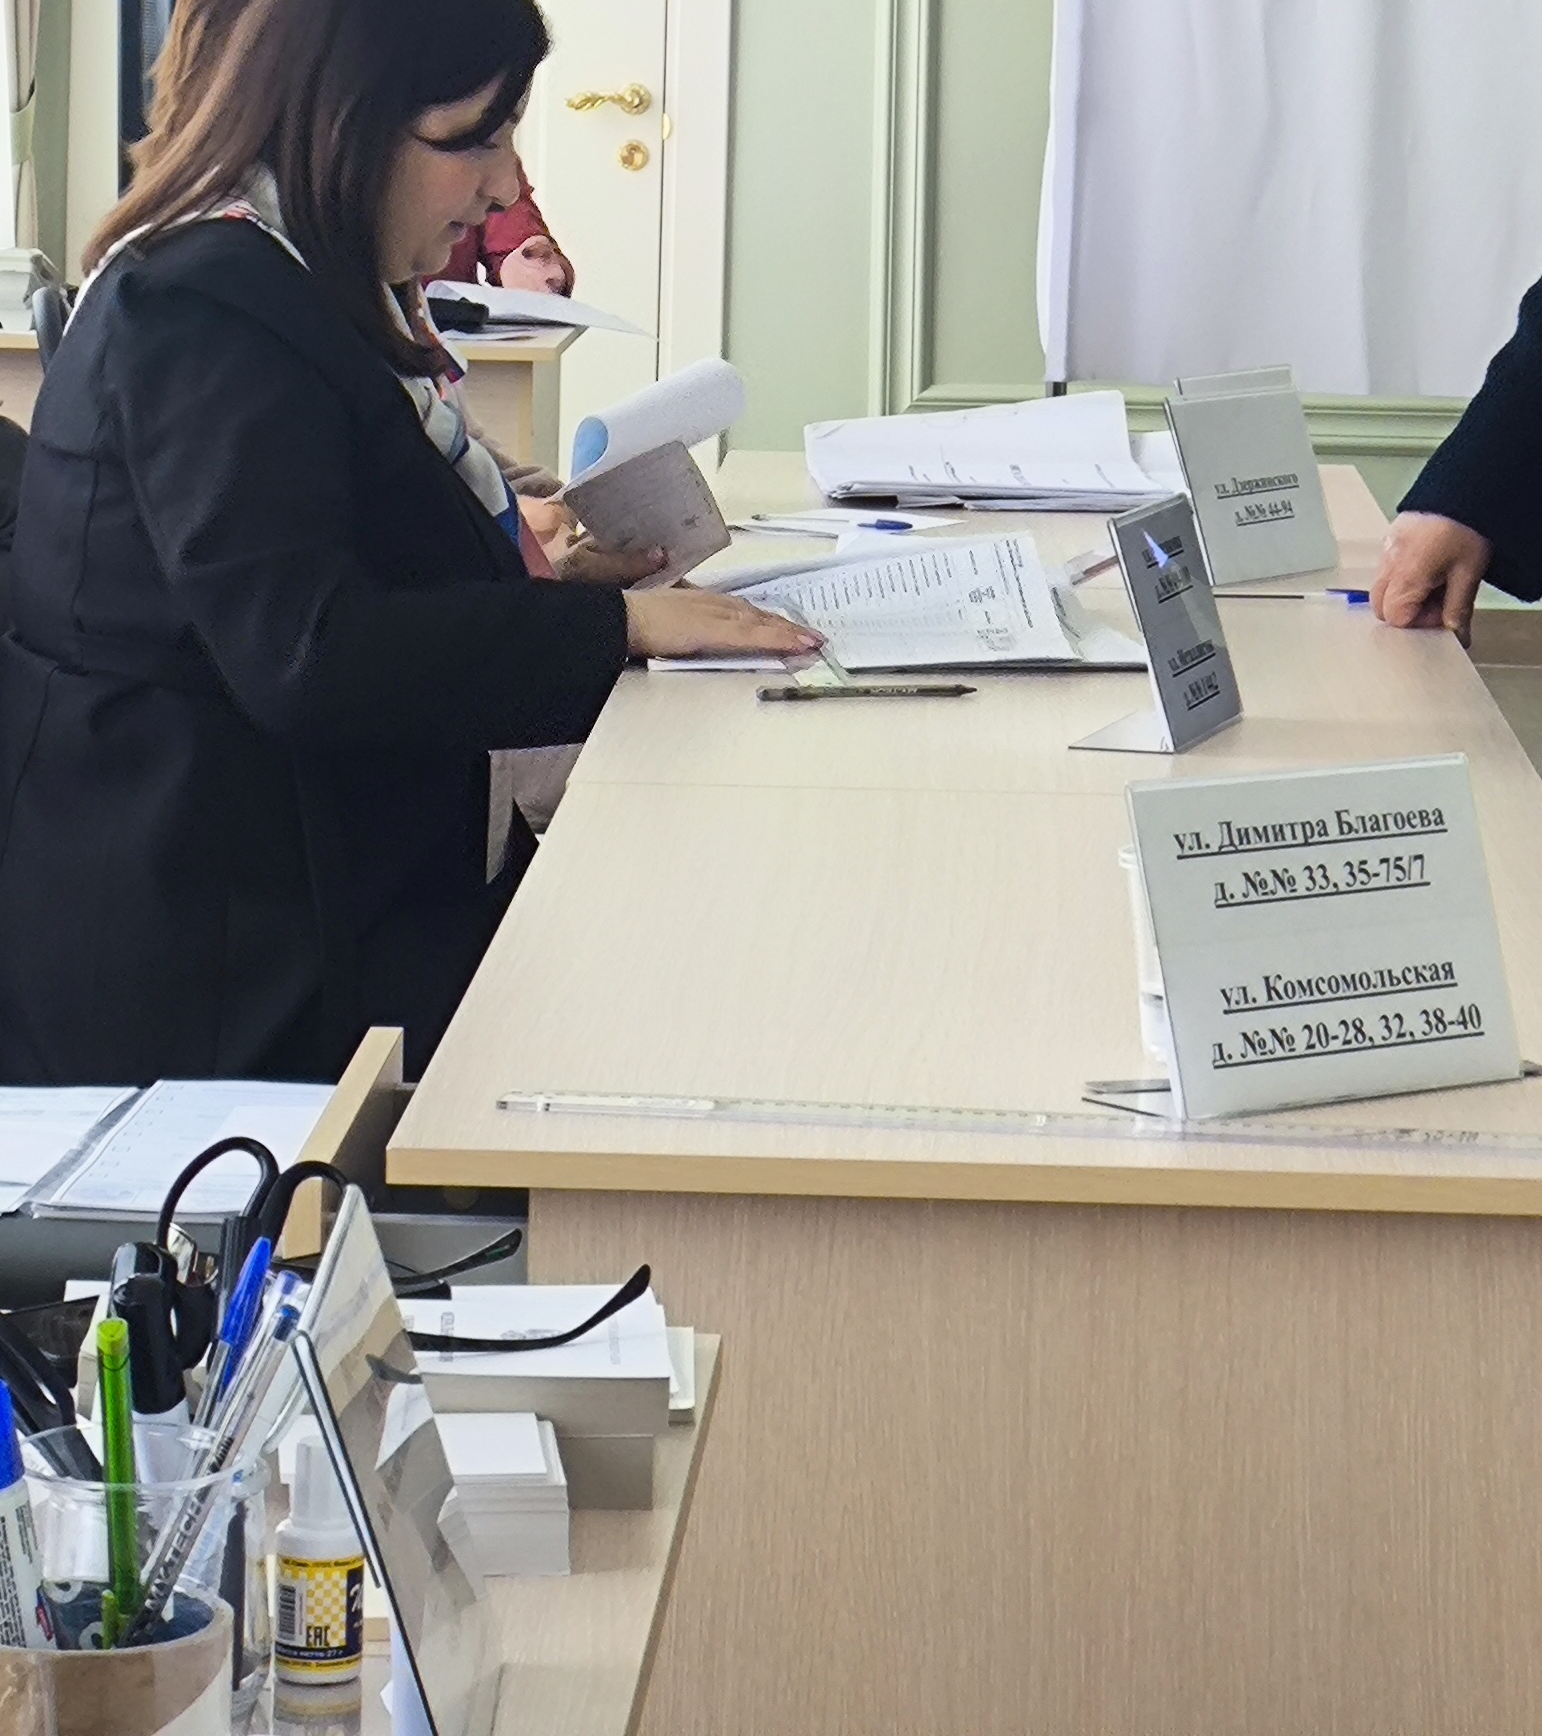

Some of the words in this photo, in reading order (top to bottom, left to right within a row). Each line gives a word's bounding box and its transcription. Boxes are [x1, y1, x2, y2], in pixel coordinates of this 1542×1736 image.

[1173, 828, 1211, 856] ул.
[1217, 818, 1330, 852] Димитра
[1334, 805, 1446, 838] Благоева
[1213, 881, 1236, 906] д.
[1242, 867, 1299, 900] №№
[1303, 862, 1340, 894] 33,
[1344, 853, 1428, 890] 35-75/7
[1220, 982, 1258, 1009] ул.
[1263, 960, 1456, 1004] Комсомольская
[1212, 1042, 1233, 1066] д.
[1240, 1029, 1296, 1061] №№
[1303, 1018, 1375, 1052] 20-28,
[1380, 1012, 1416, 1043] 32,
[1420, 1003, 1482, 1037] 38-40
